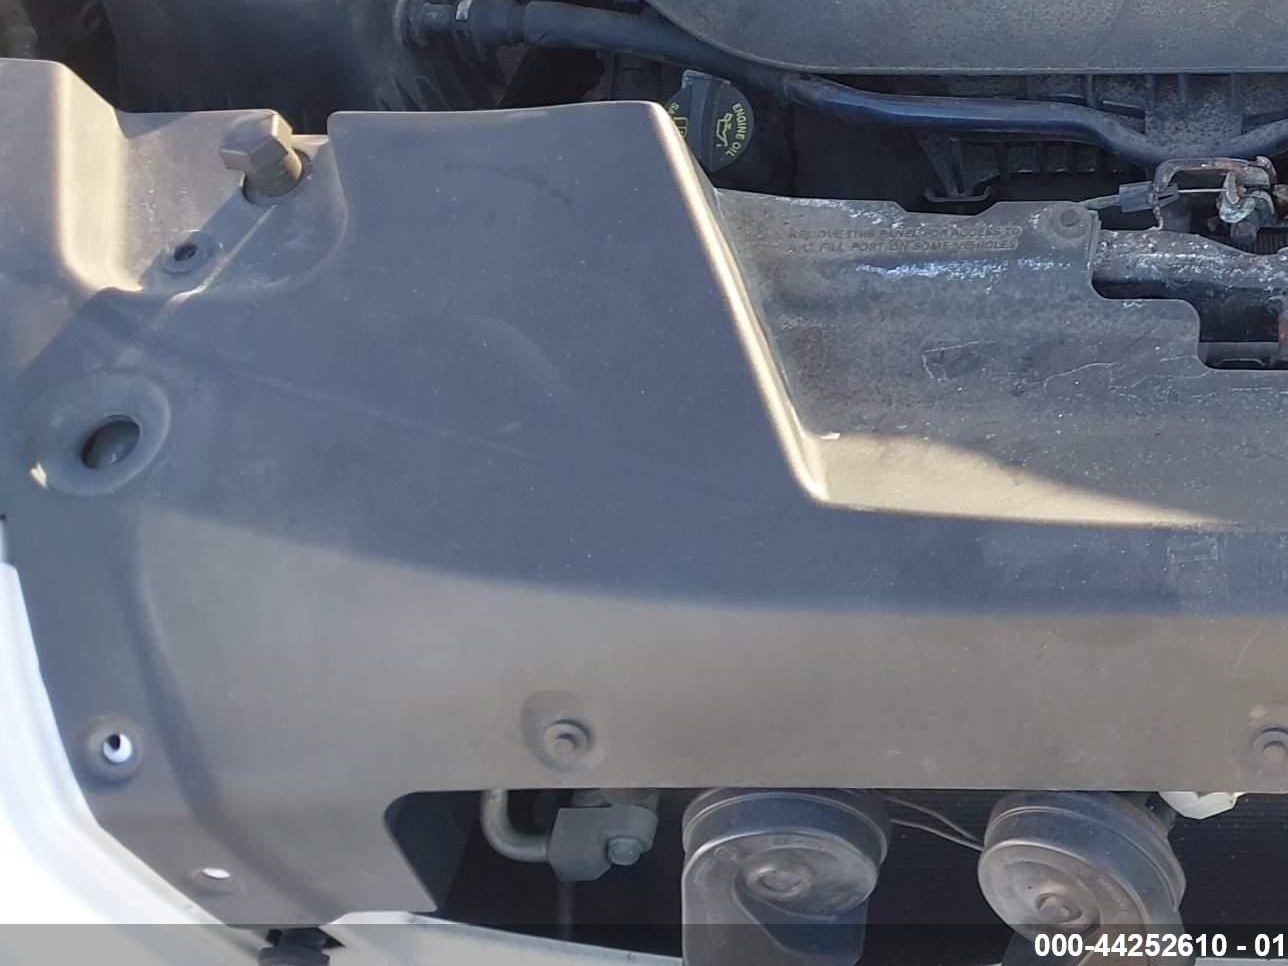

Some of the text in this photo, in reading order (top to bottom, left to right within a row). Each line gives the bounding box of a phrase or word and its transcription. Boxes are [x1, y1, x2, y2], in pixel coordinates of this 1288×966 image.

[724, 102, 748, 157] ENGINE OIL
[851, 242, 887, 252] PORT
[888, 242, 909, 251] ON
[911, 241, 950, 251] SOME
[951, 240, 1017, 251] VEHICLES
